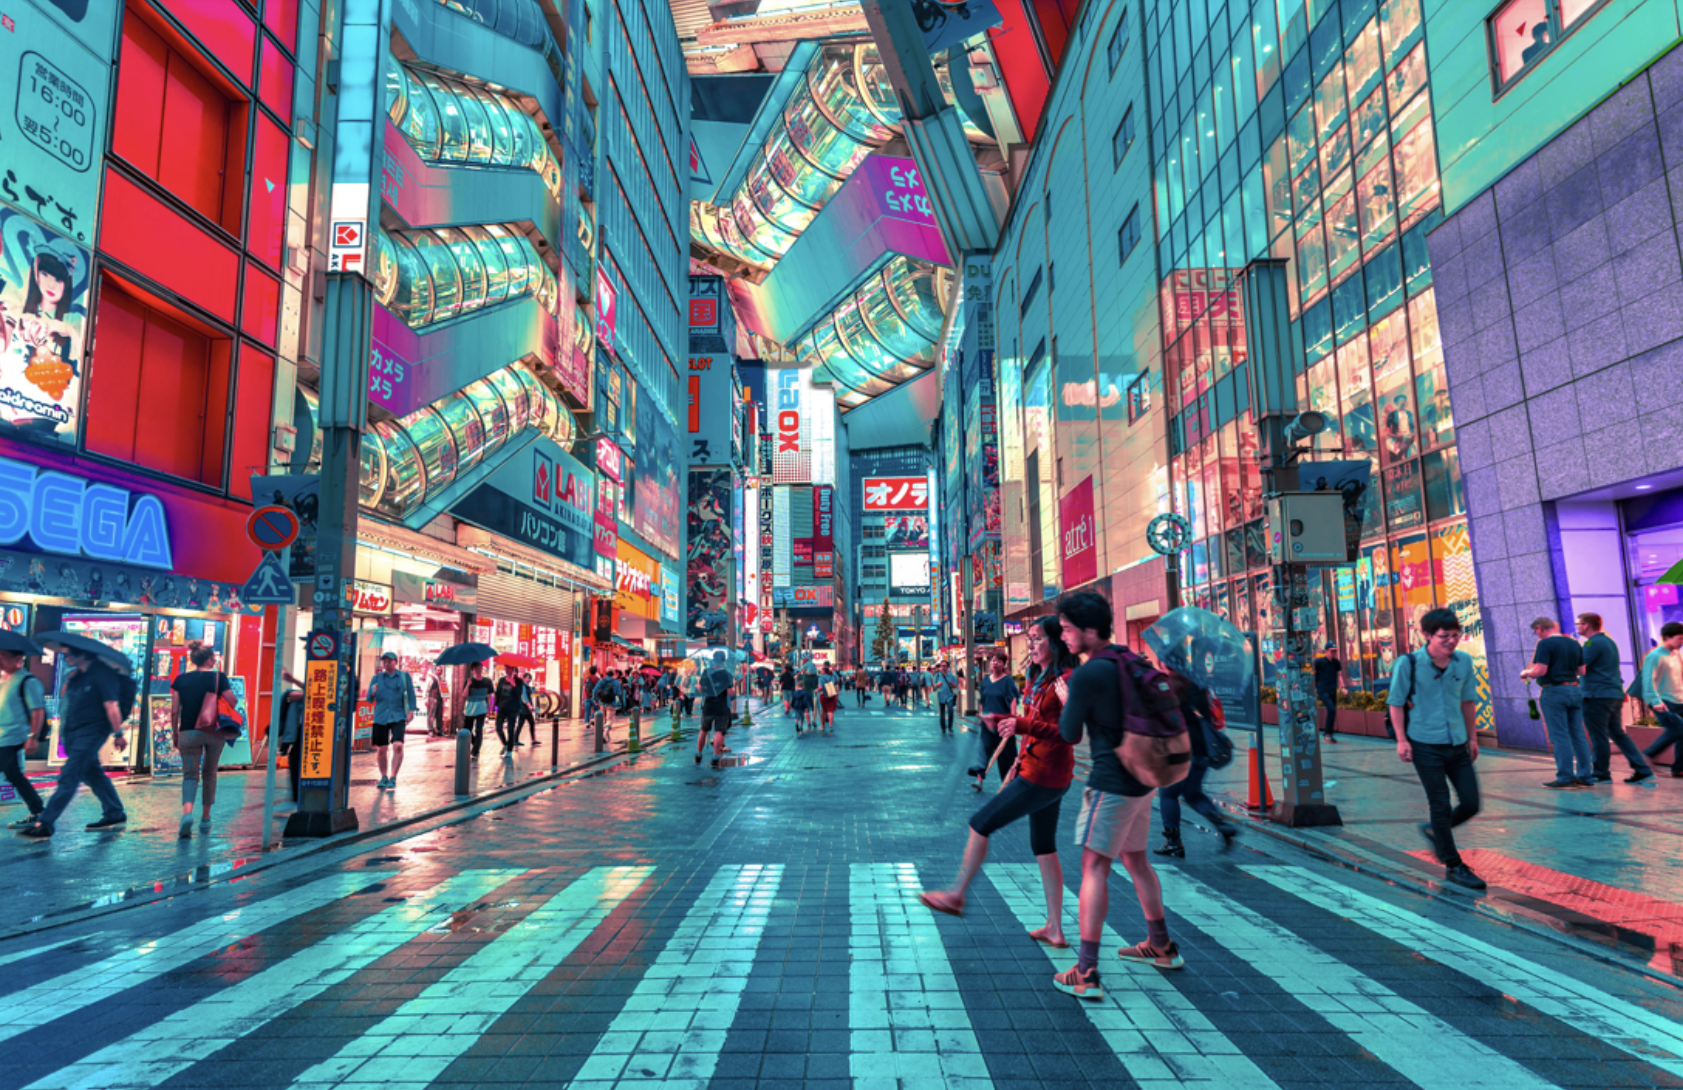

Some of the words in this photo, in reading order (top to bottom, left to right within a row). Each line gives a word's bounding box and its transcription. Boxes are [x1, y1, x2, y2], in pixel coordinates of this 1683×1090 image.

[30, 75, 86, 127] 16:00
[0, 456, 173, 572] SEGA
[555, 463, 592, 517] LABI
